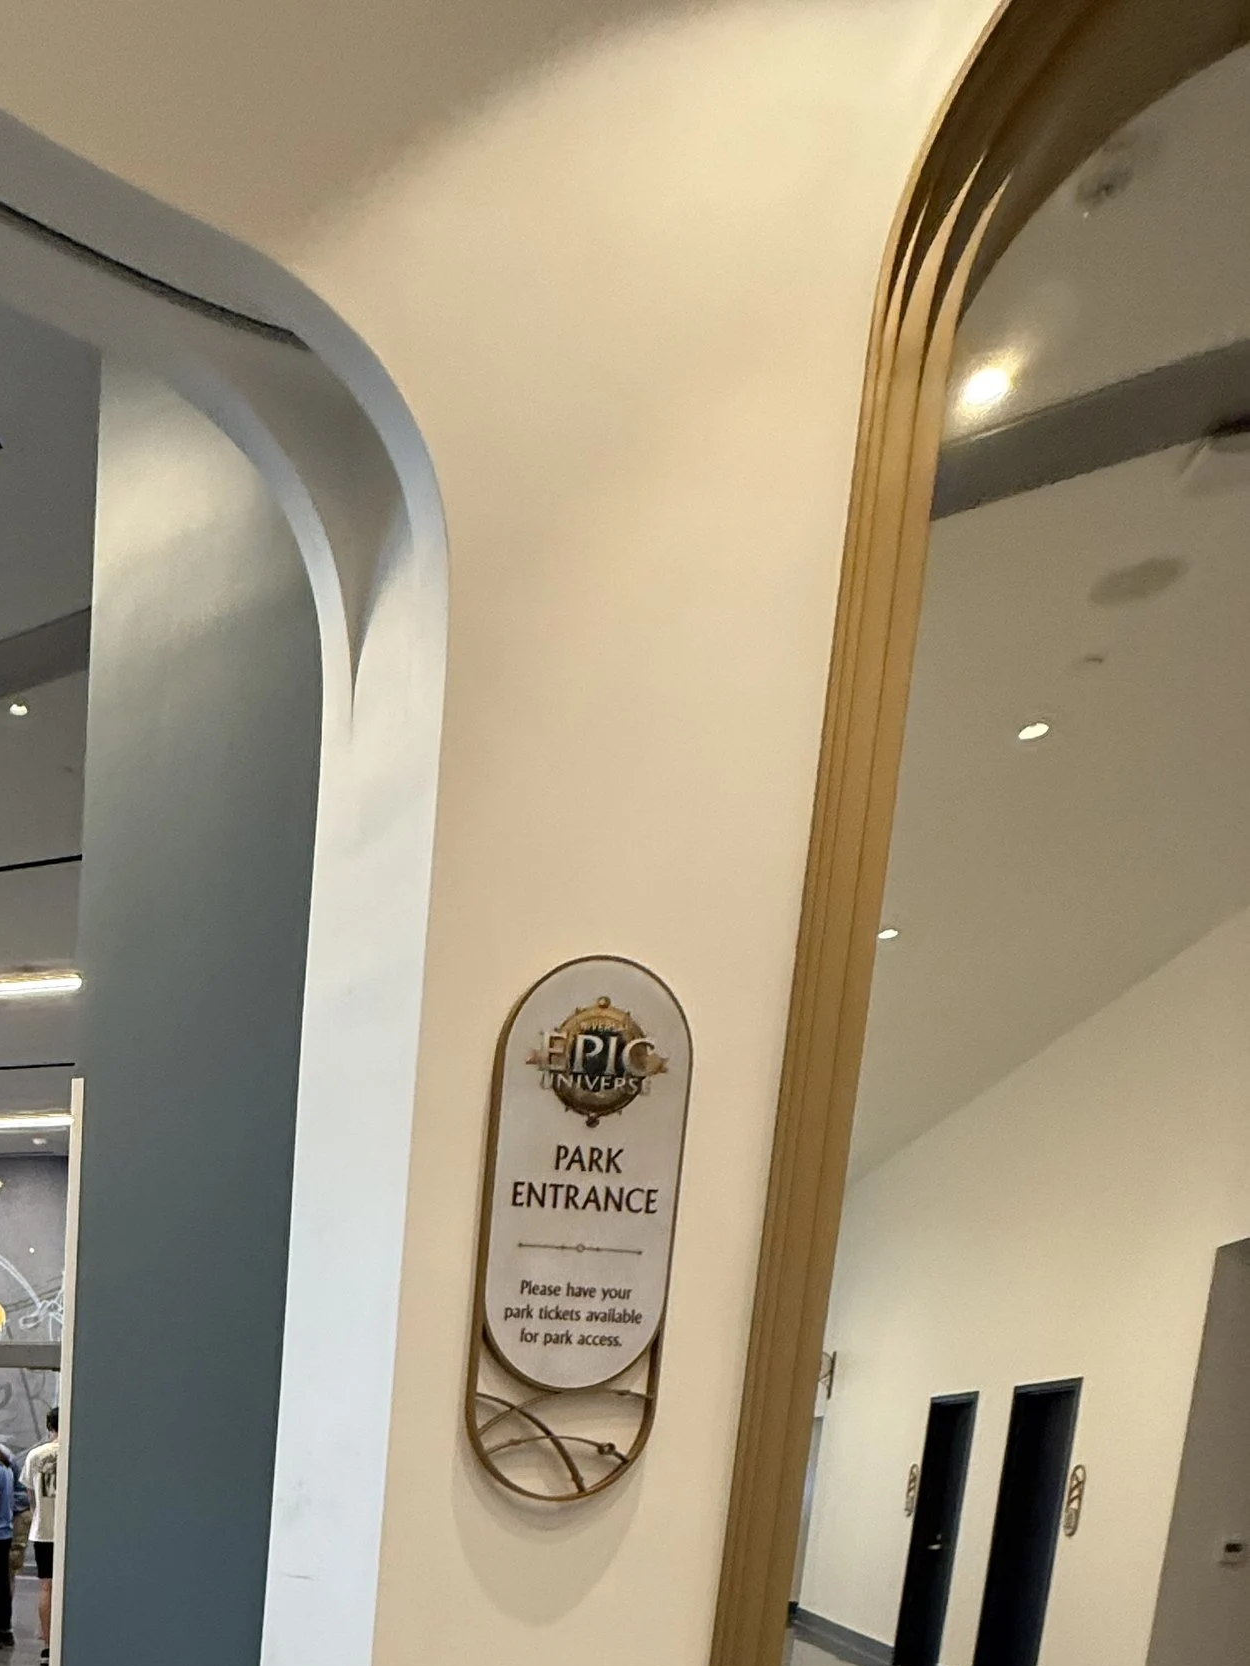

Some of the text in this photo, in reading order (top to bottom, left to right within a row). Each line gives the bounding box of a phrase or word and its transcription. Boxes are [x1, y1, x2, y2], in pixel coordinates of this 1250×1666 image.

[540, 1031, 655, 1078] EPIC
[554, 1145, 623, 1174] PARK
[511, 1182, 658, 1214] ENTRANCE
[520, 1280, 632, 1301] Please have your
[504, 1304, 642, 1324] park tickets available
[520, 1328, 622, 1347] for park access.
